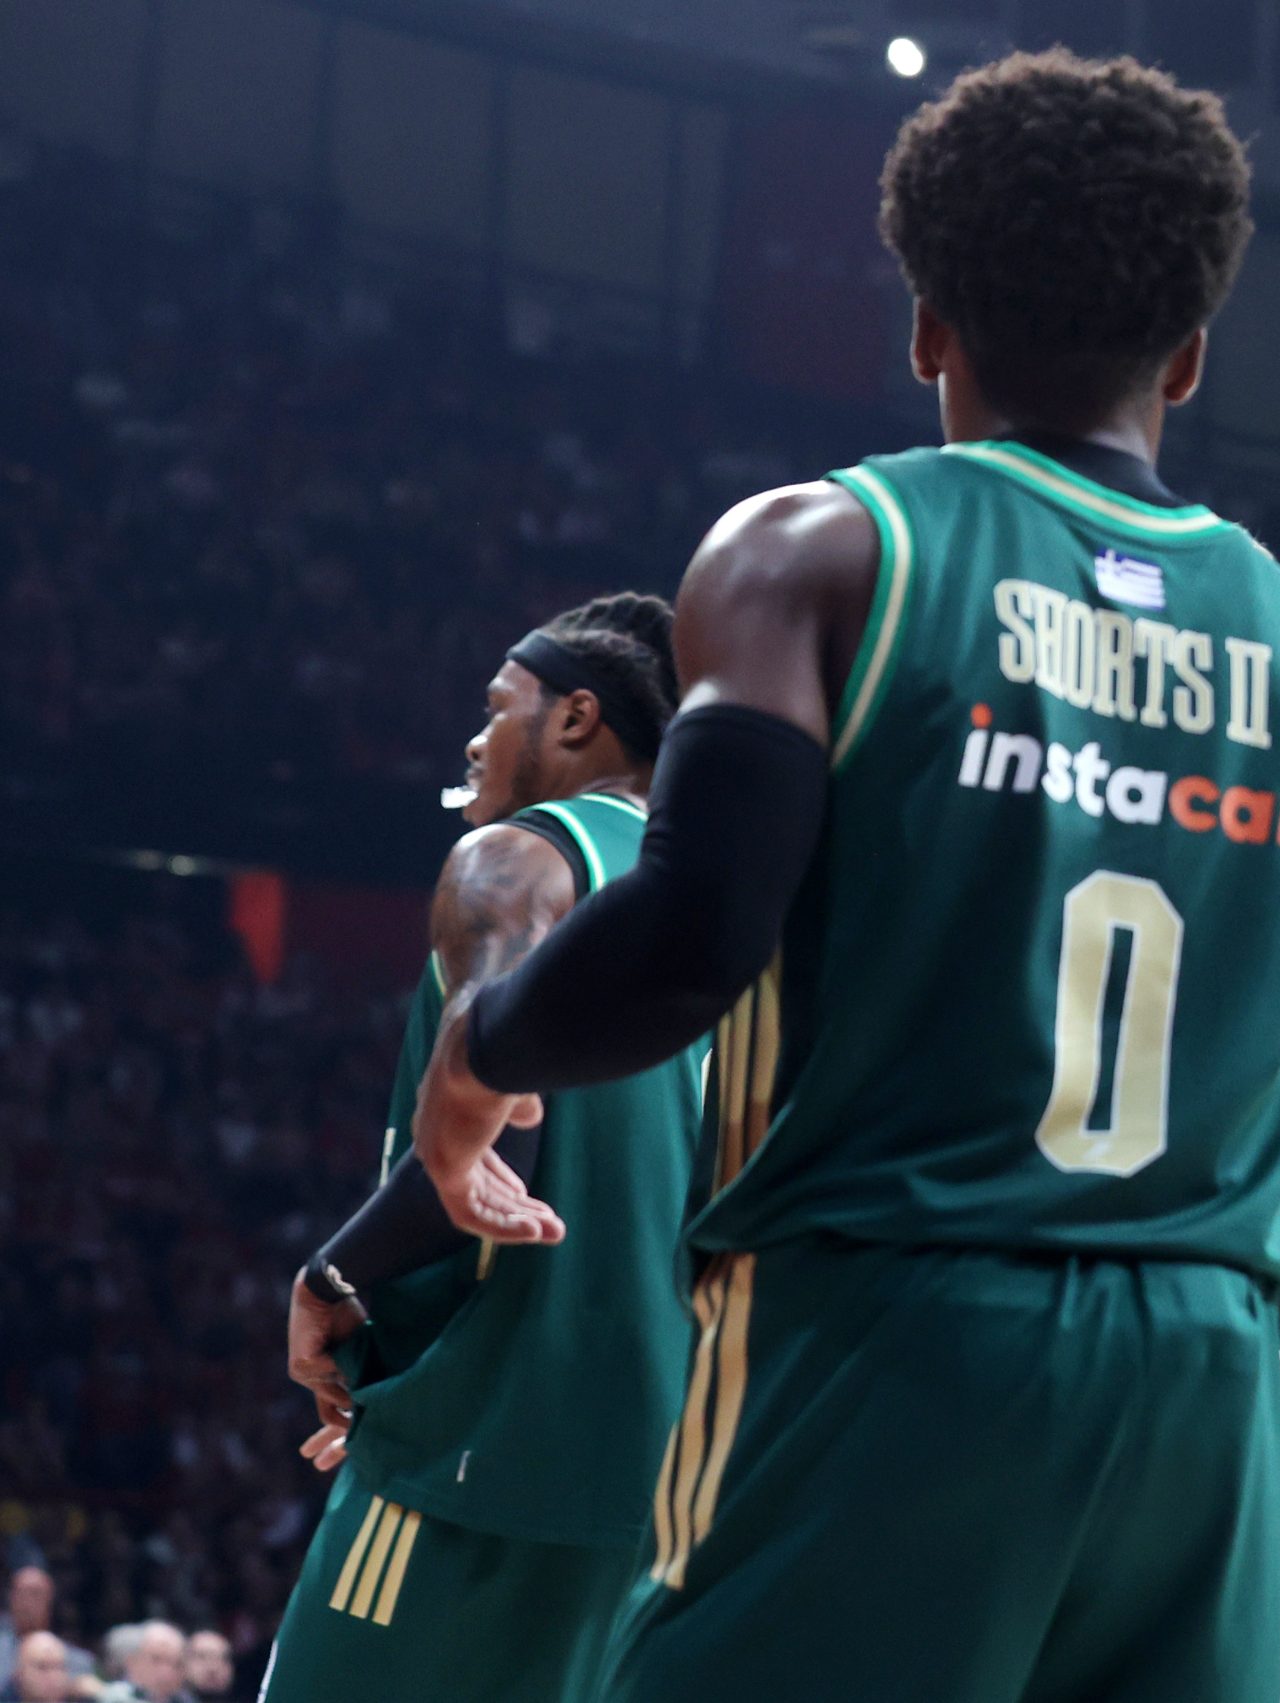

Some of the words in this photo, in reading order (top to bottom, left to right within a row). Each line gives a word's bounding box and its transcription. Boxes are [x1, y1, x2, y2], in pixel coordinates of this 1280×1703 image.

[993, 578, 1214, 735] SHORTS
[1225, 637, 1272, 749] II
[1034, 868, 1185, 1178] 0
